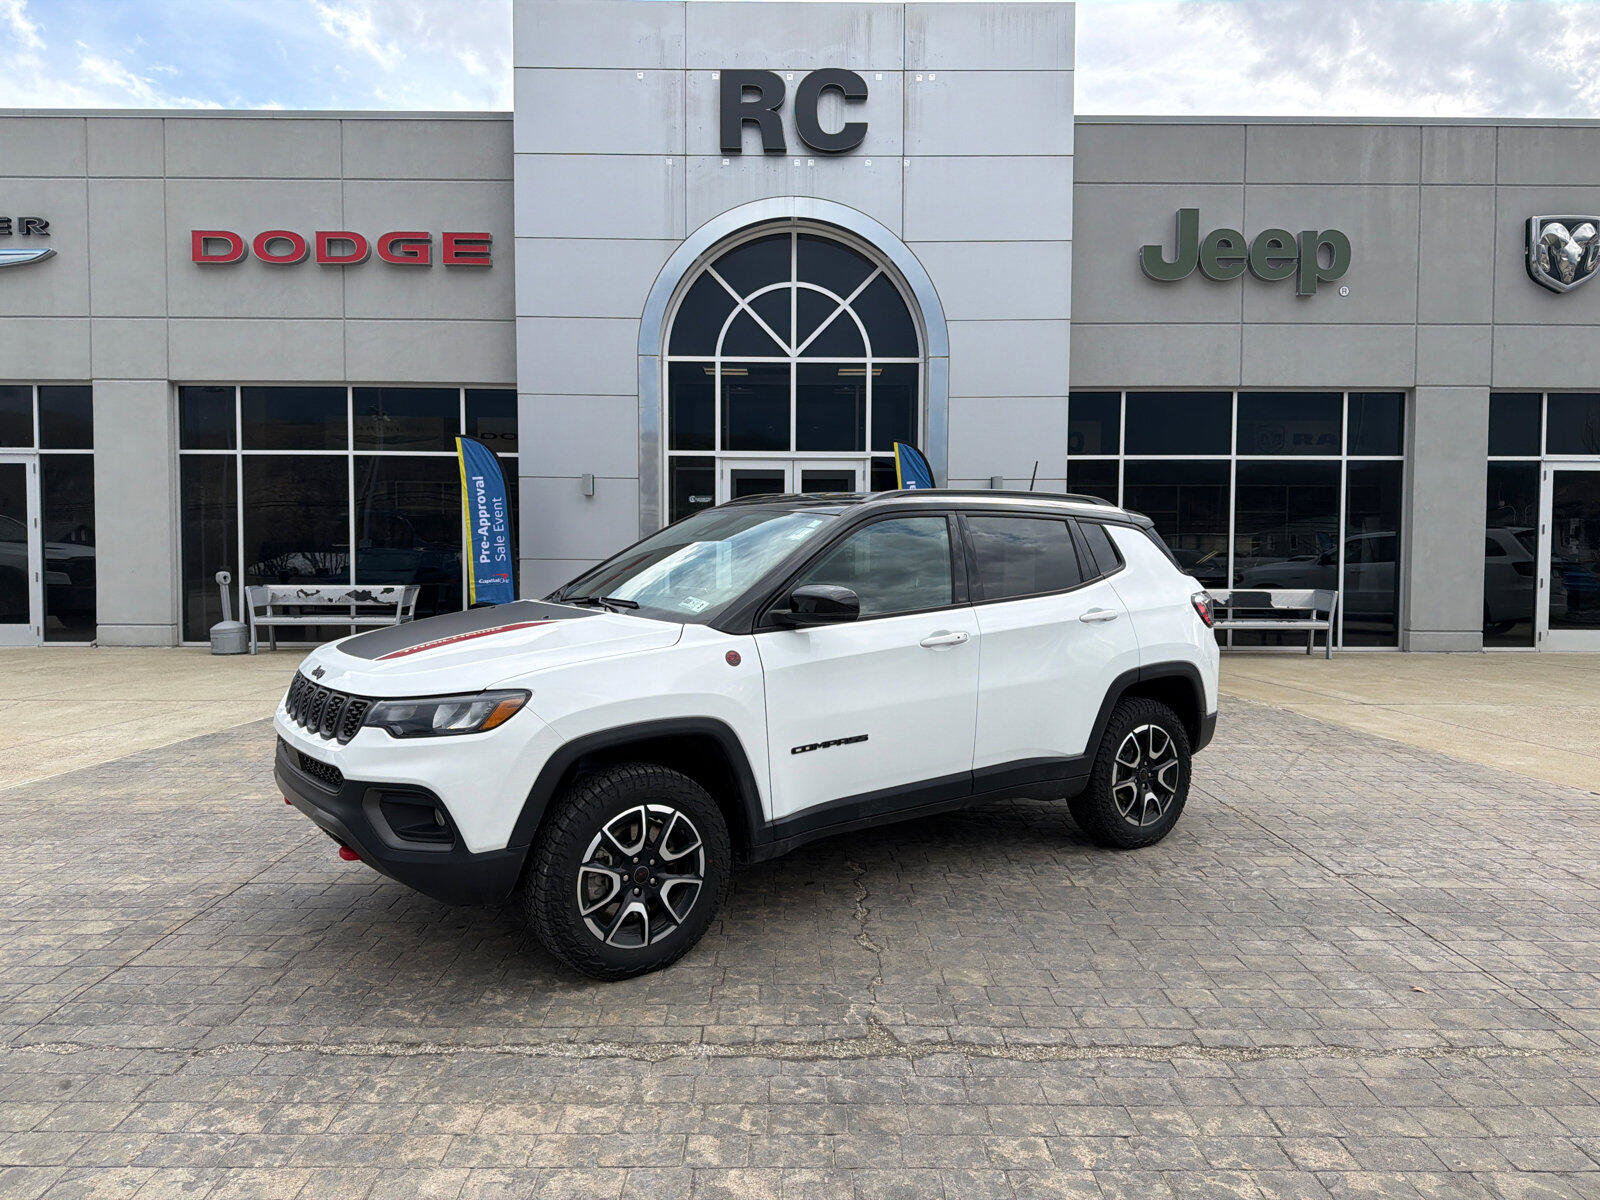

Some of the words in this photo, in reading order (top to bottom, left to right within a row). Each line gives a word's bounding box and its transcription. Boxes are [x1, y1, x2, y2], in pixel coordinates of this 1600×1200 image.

[720, 68, 868, 153] RC
[0, 216, 50, 236] ER
[191, 230, 493, 267] DODGE
[1140, 208, 1351, 296] Jeep
[472, 476, 491, 564] Pre-Approval
[492, 497, 505, 532] Event
[494, 535, 507, 562] Sale
[791, 734, 869, 755] COMPASS
